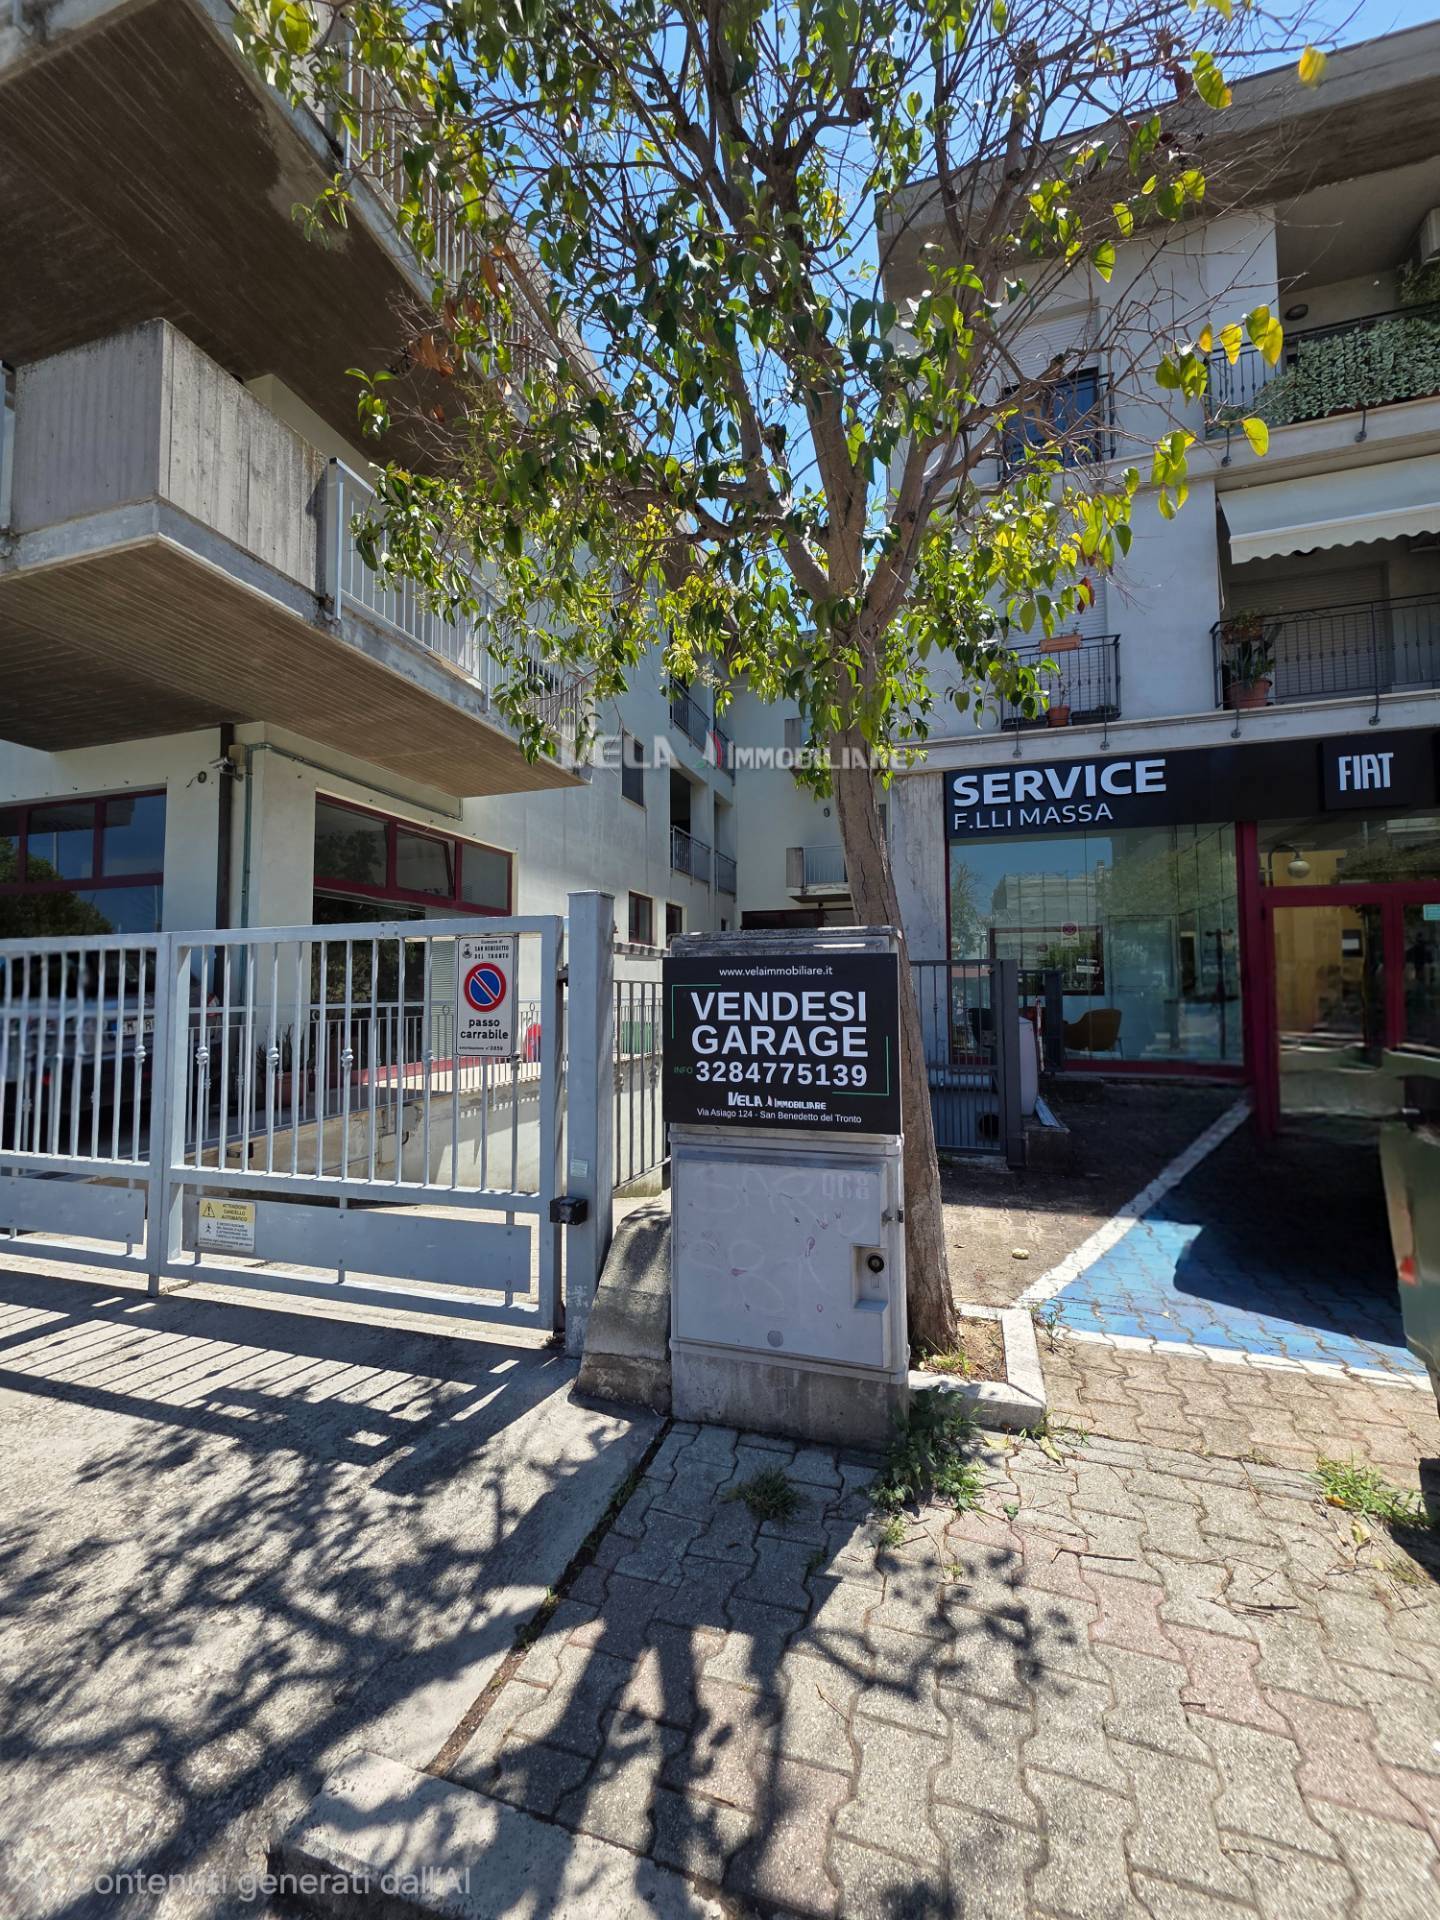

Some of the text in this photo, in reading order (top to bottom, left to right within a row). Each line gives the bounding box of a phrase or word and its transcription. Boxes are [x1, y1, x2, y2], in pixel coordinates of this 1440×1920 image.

[953, 758, 1167, 807] SERVICE
[1338, 752, 1394, 791] FIAT
[954, 802, 1113, 830] F.LLI MASSA
[719, 965, 833, 976] www.velaimmobiliare.it
[690, 990, 867, 1023] VENDESI
[460, 1029, 509, 1040] carrabile
[468, 1019, 500, 1029] passo
[691, 1024, 869, 1058] GARAGE
[696, 1060, 867, 1087] 3284775139
[727, 1091, 827, 1110] VELA IMMOBILIARE
[697, 1107, 710, 1117] Via
[709, 1108, 737, 1119] Asiago
[738, 1109, 753, 1118] 124
[759, 1110, 776, 1120] San
[777, 1111, 819, 1121] Benedetto
[820, 1113, 833, 1122] del
[834, 1114, 862, 1124] Tronto
